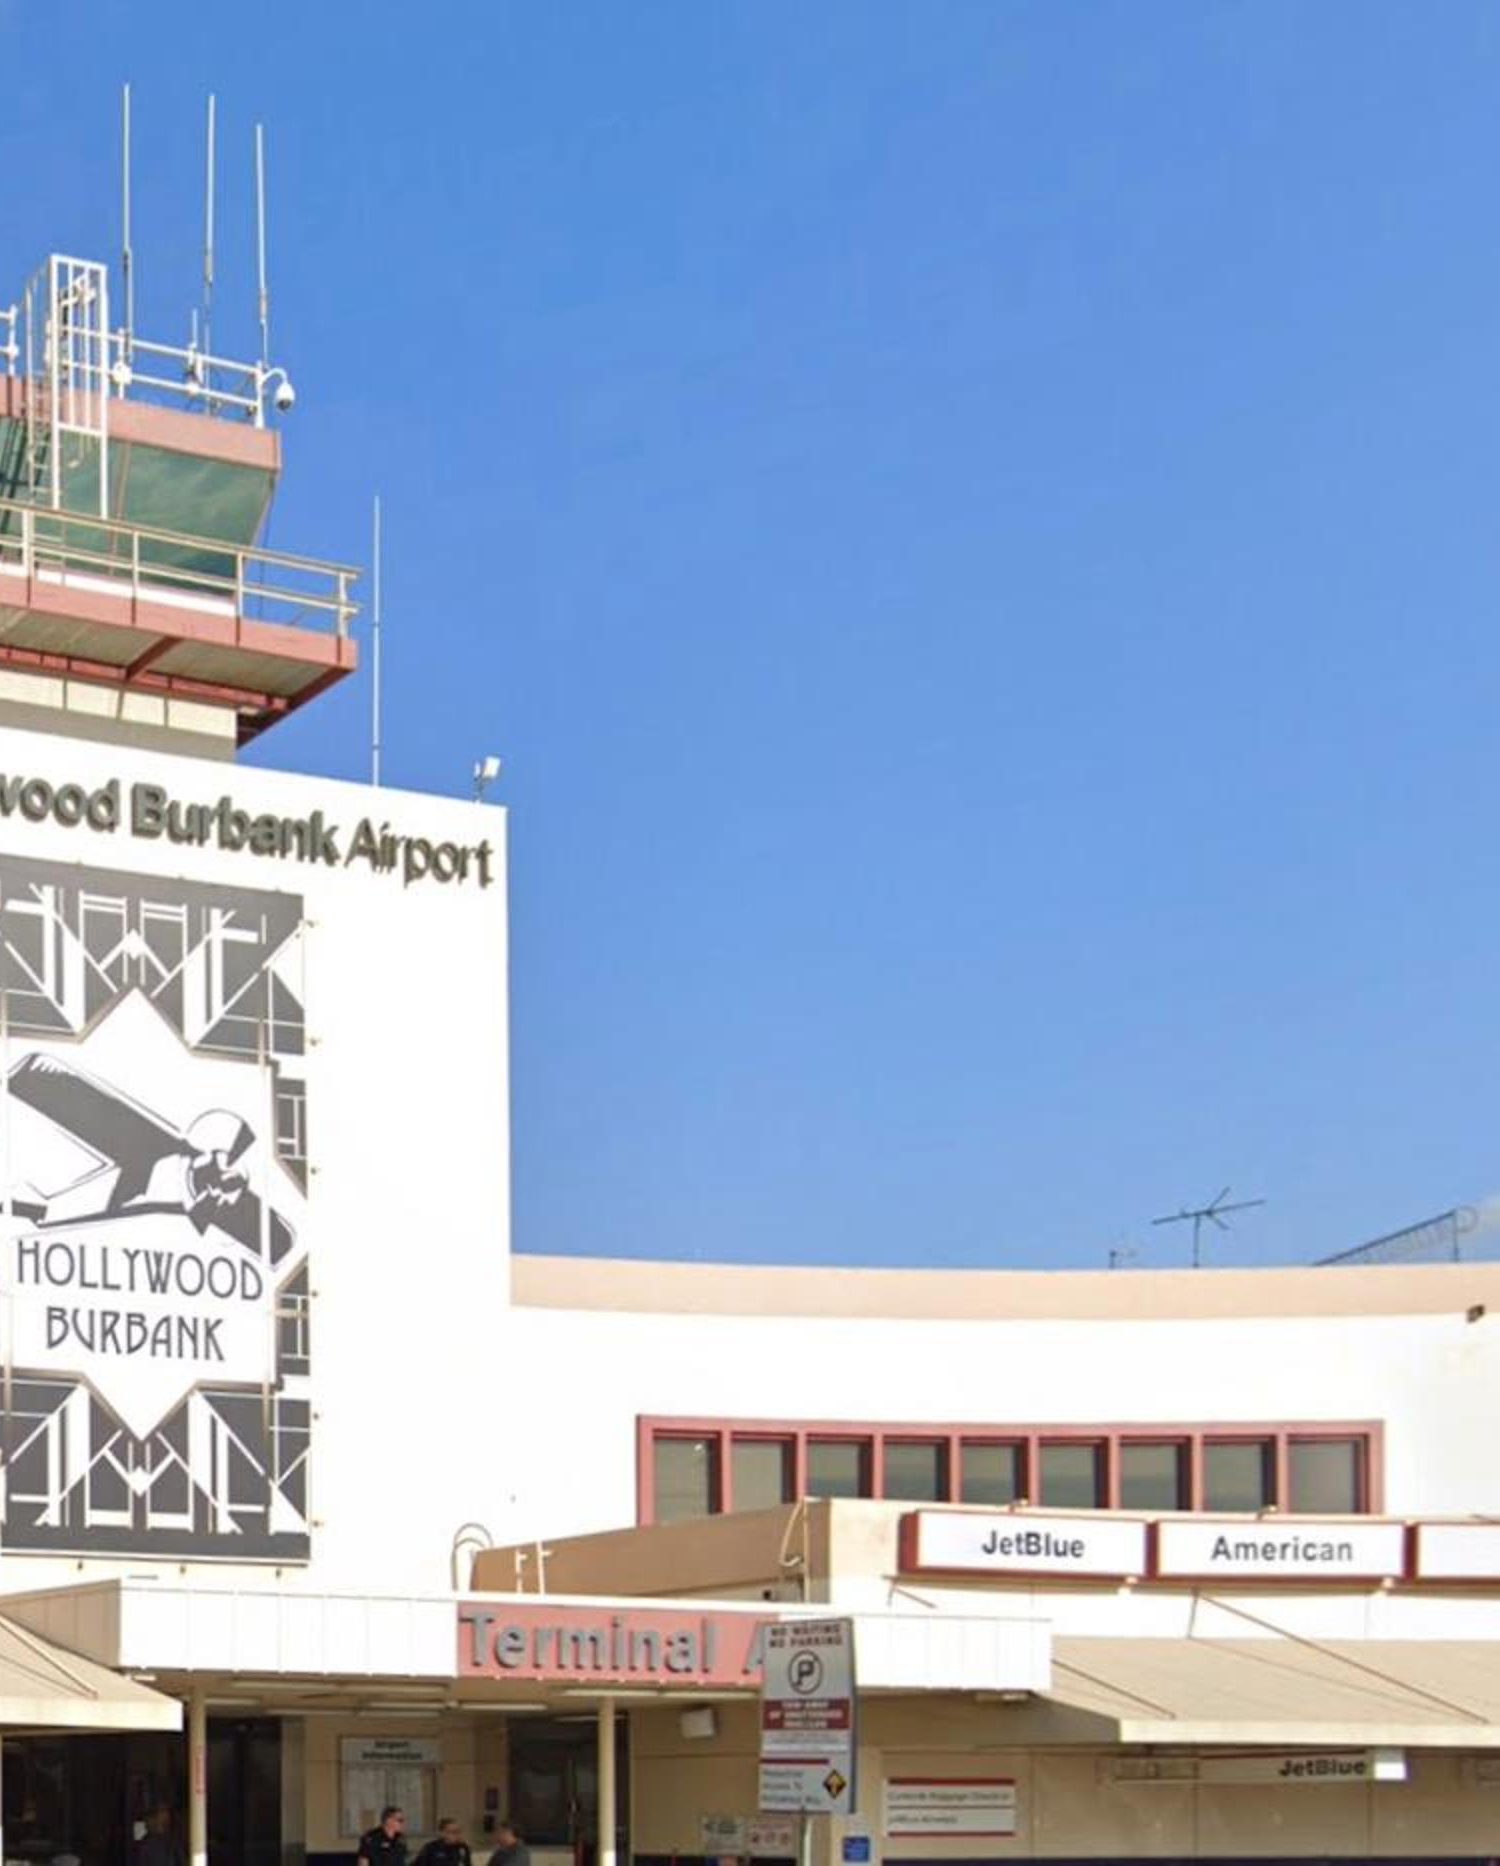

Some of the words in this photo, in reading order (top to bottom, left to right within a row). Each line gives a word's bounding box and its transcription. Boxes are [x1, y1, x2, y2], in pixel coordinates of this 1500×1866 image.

[130, 783, 341, 867] Burbank
[344, 817, 494, 889] Airport
[18, 1239, 263, 1301] HOLLYWOOD
[46, 1306, 225, 1361] BURBANK
[982, 1530, 1085, 1558] JetBlue
[1211, 1536, 1353, 1562] American
[459, 1611, 715, 1674] Terminal
[1278, 1759, 1365, 1777] JetBlue
